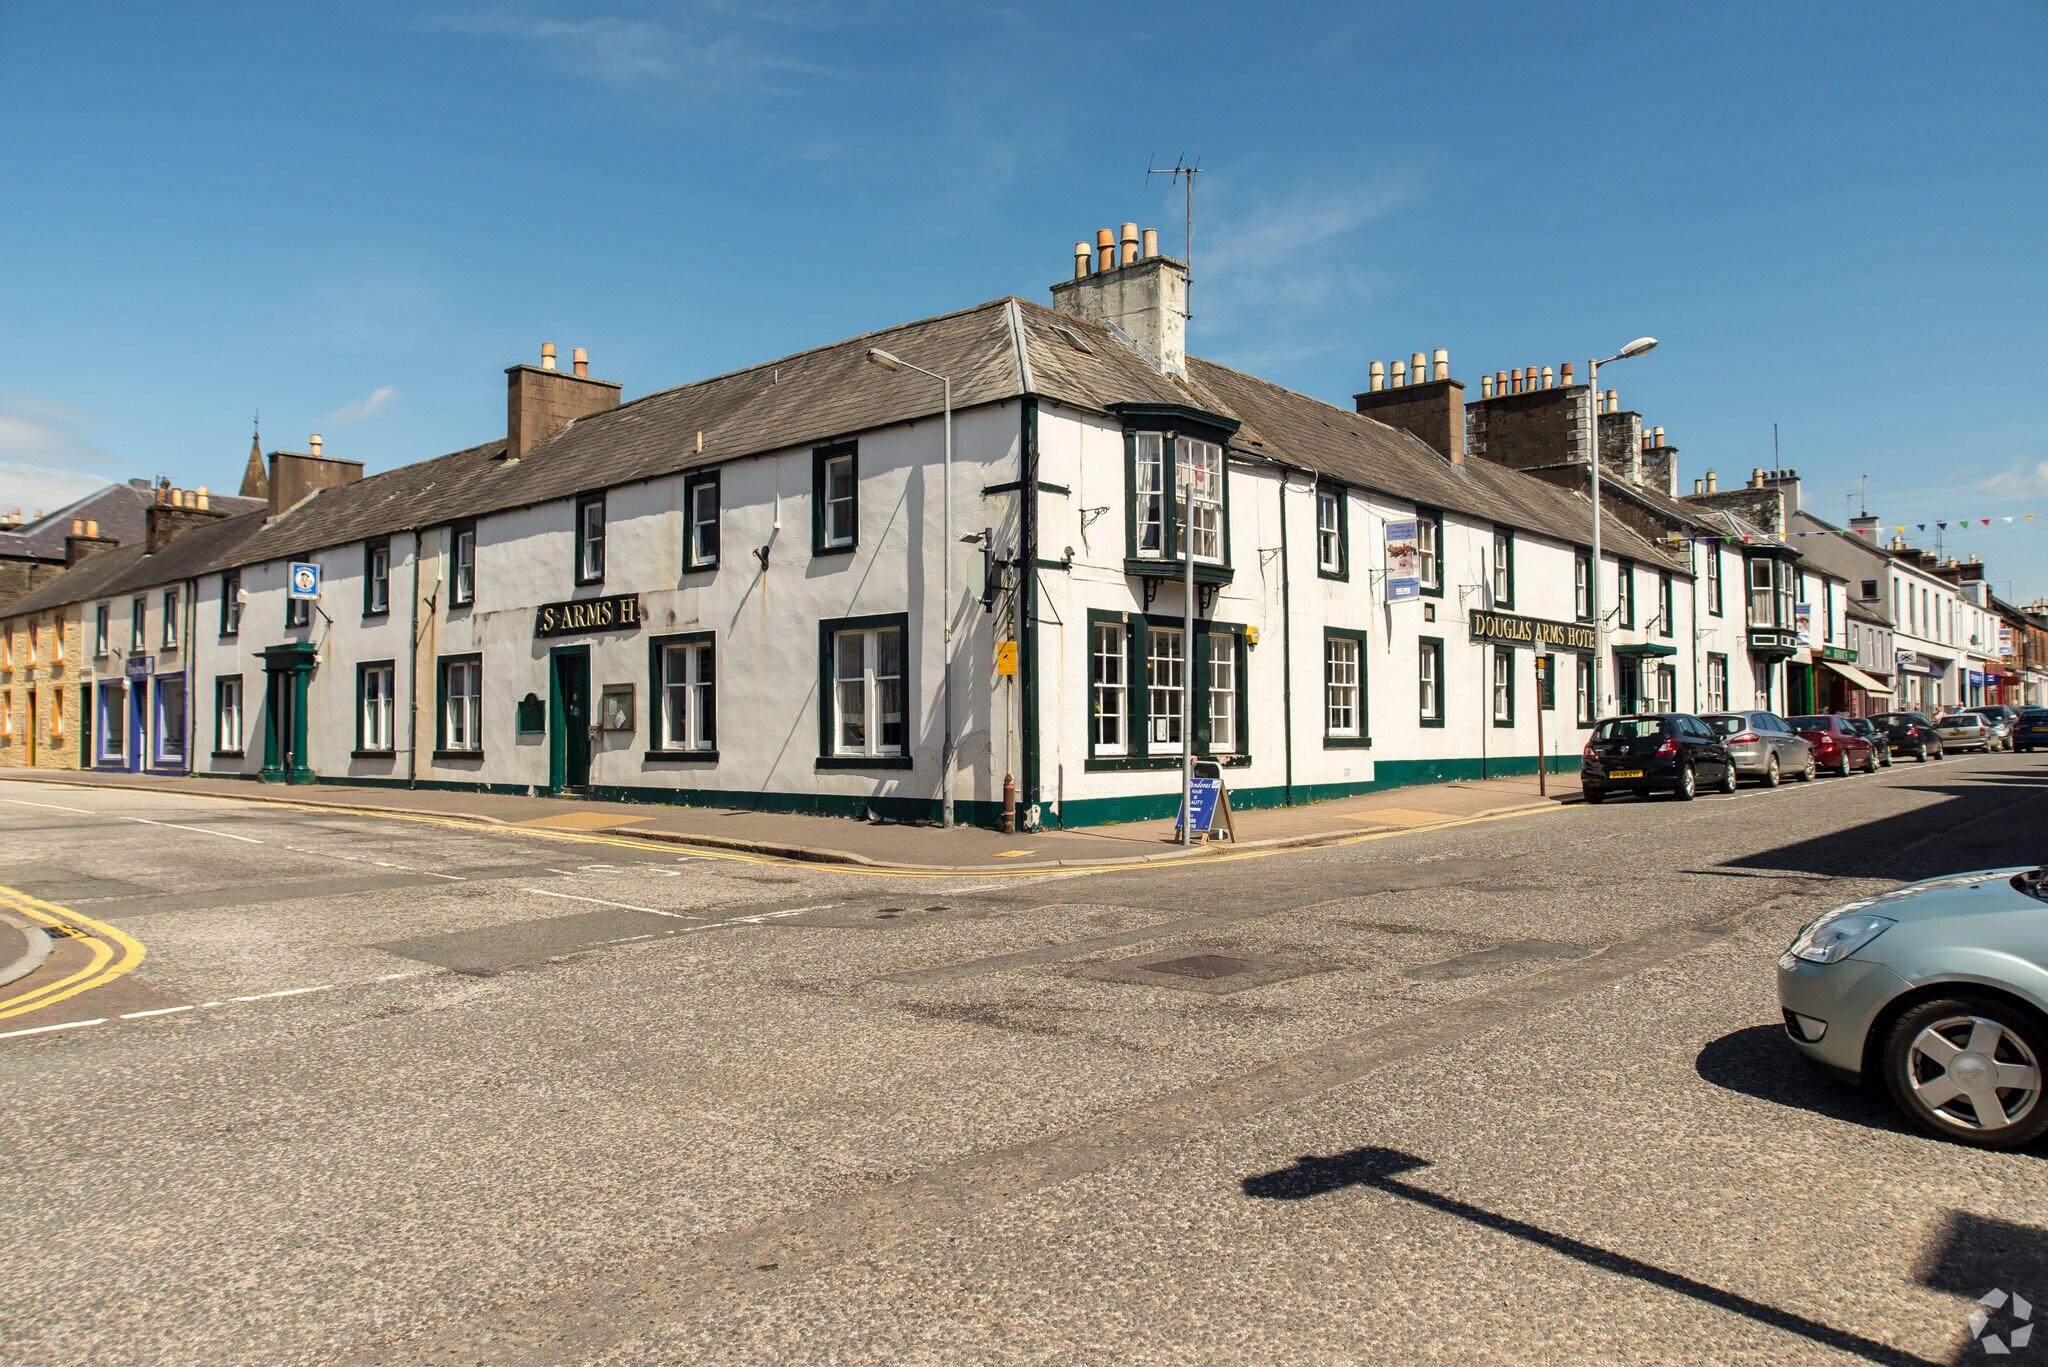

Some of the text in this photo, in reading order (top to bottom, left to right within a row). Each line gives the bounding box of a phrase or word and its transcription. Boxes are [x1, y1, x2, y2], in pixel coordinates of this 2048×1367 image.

[543, 598, 635, 631] S ARMS H
[1475, 615, 1596, 649] DOUGLAS ARMS HOTE
